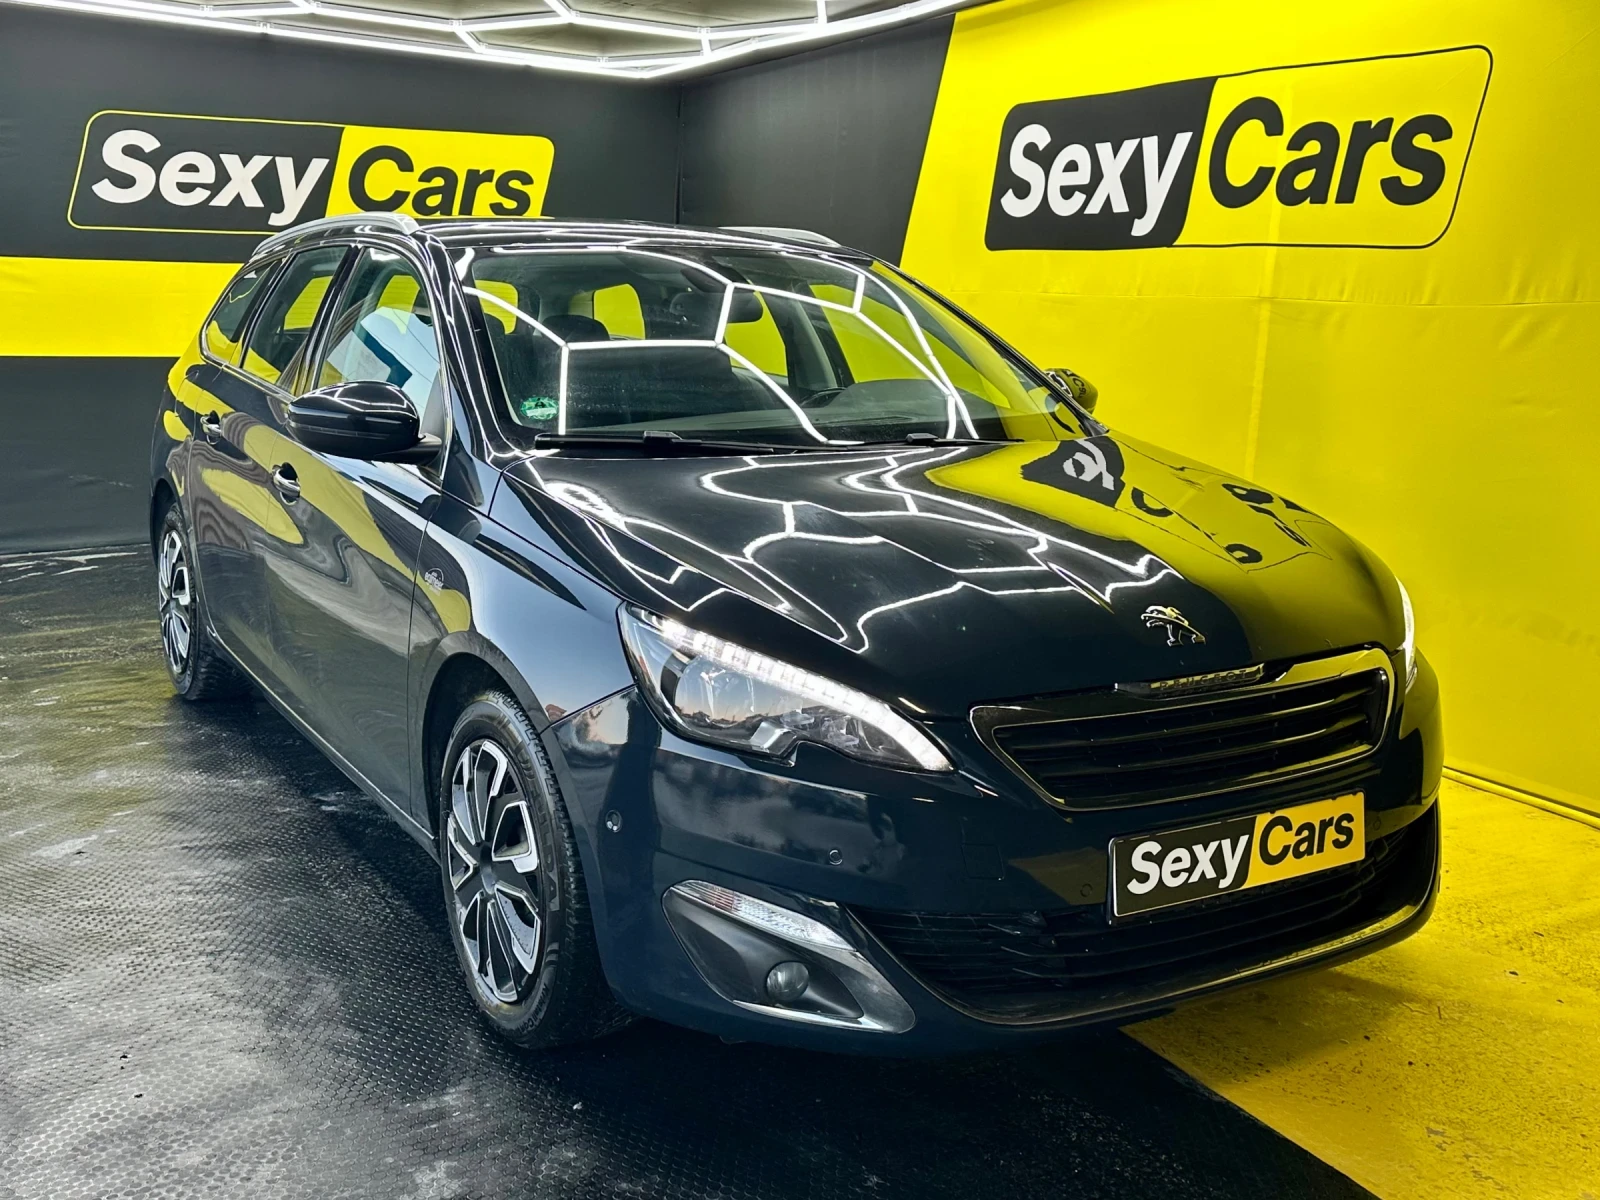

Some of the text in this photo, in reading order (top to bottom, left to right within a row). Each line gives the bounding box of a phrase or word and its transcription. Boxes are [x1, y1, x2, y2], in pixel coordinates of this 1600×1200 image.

[92, 129, 534, 227] Sexy Cars
[1000, 96, 1453, 237] Sexy Cars
[1160, 669, 1247, 691] PEUGEOT
[1127, 813, 1354, 895] Sexy Cars
